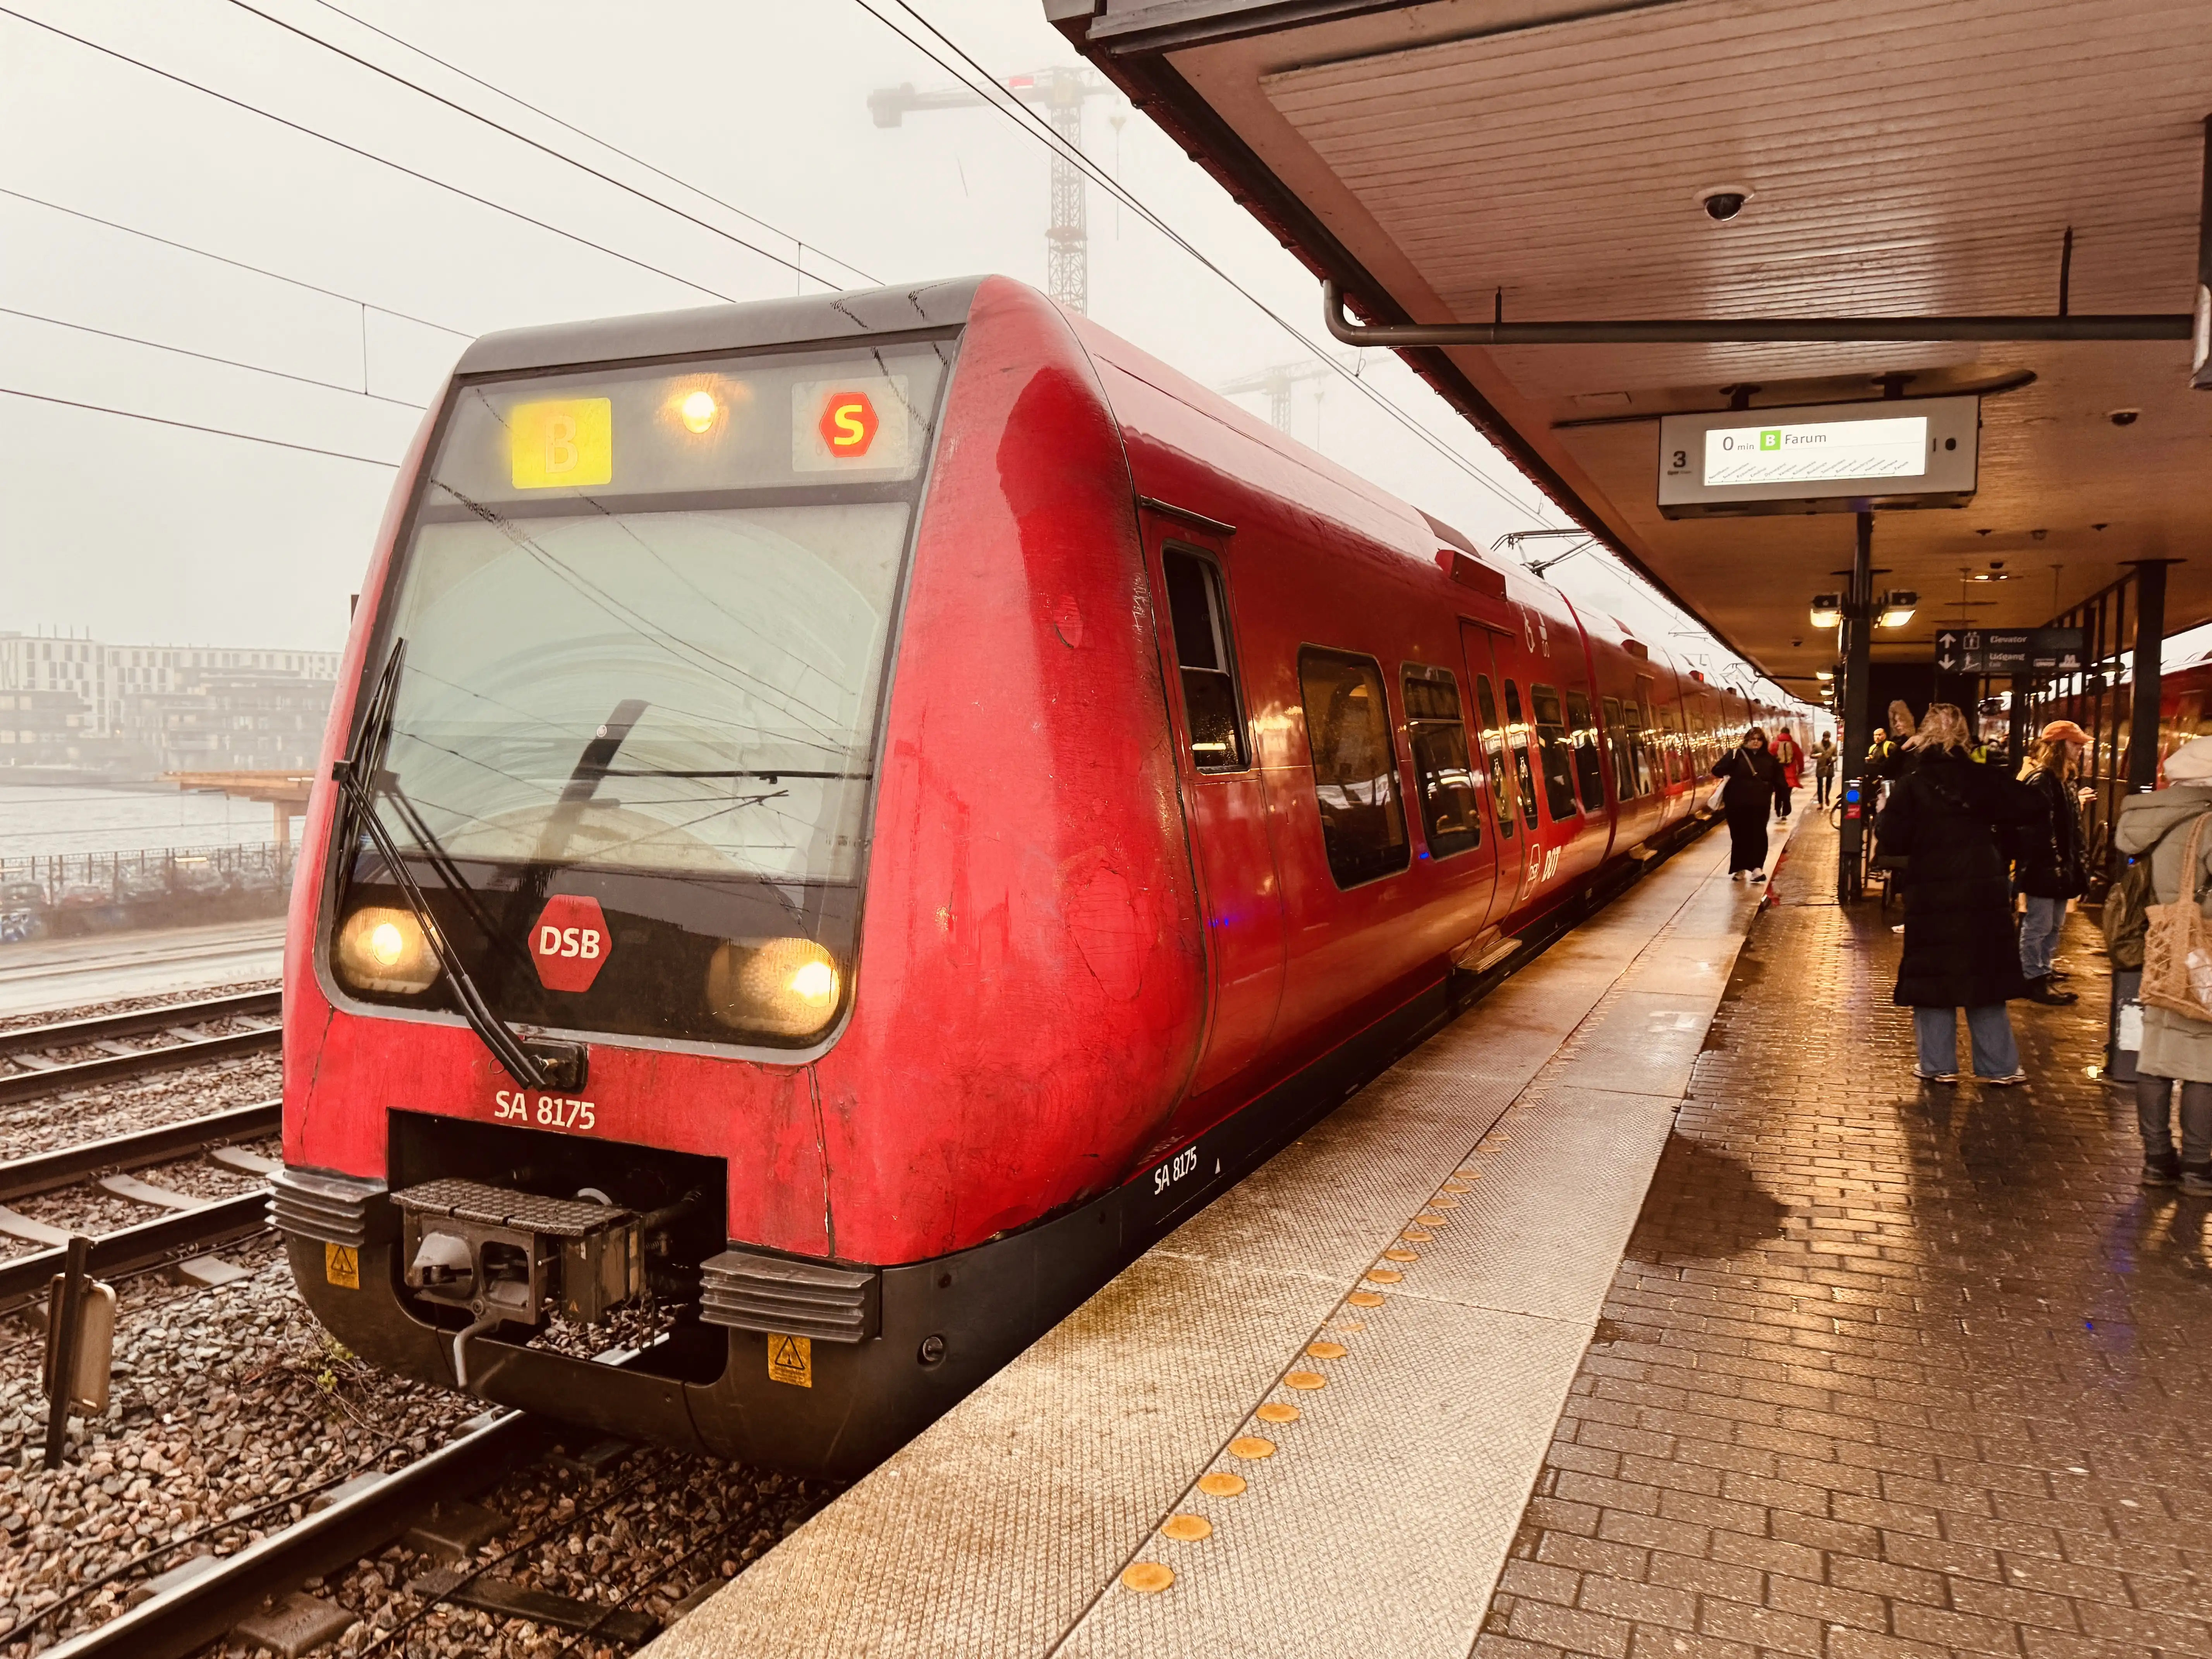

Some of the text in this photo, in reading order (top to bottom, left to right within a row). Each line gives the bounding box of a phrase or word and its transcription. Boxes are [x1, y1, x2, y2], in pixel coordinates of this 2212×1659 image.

[545, 415, 578, 474] B
[834, 404, 864, 446] S
[1723, 436, 1734, 451] 0
[1765, 434, 1776, 447] B
[1785, 434, 1827, 445] Farum
[1673, 450, 1686, 468] 3
[539, 926, 600, 959] DSB
[494, 1090, 596, 1130] SA 8175
[1154, 1146, 1197, 1195] SA 8175
